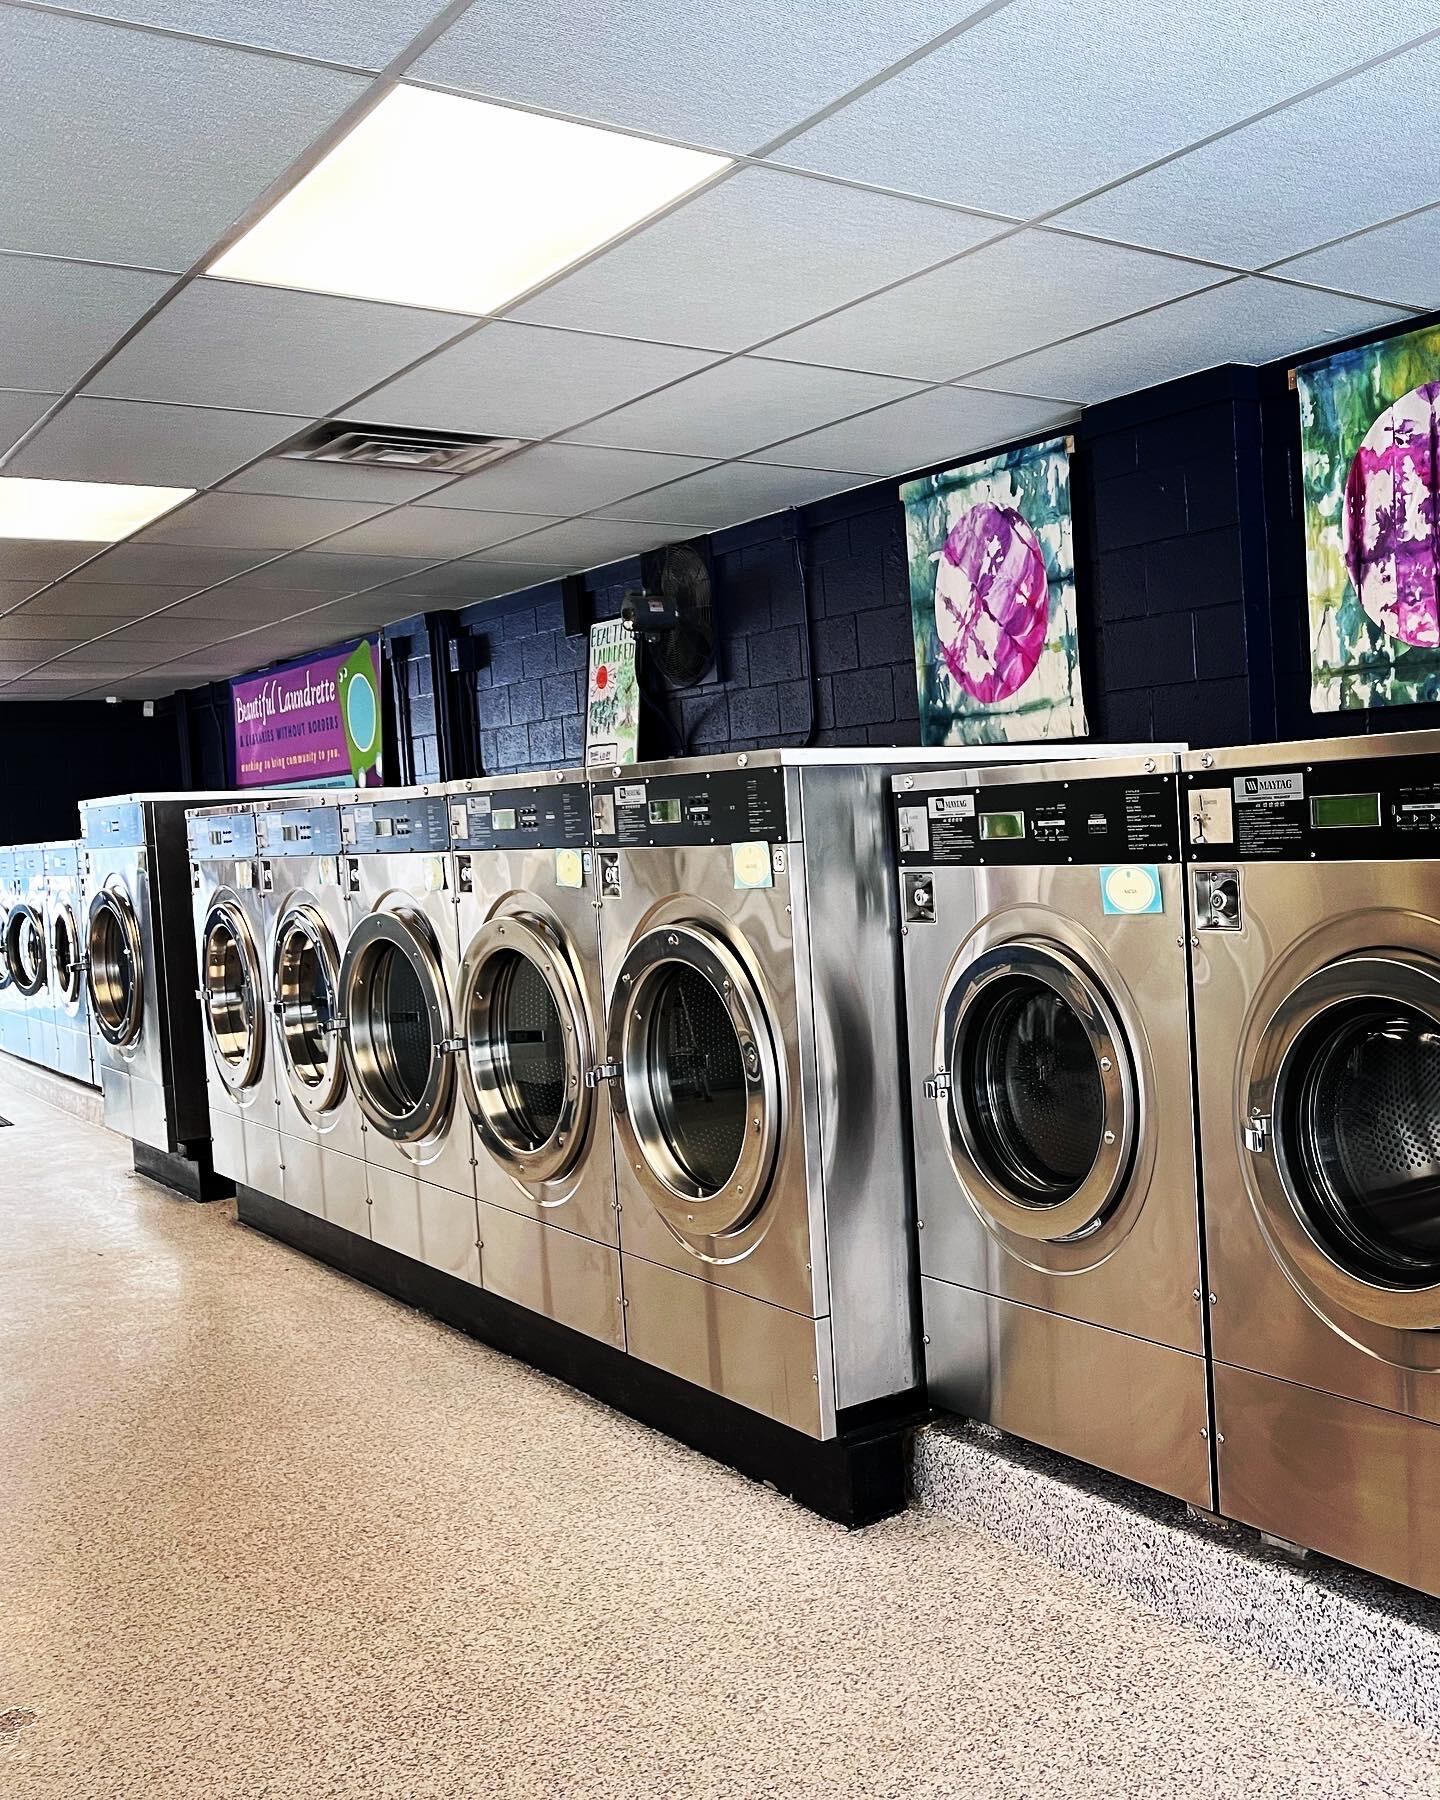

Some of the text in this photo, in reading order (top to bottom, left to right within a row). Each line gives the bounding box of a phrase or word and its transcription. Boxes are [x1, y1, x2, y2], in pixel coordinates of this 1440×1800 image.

[591, 623, 634, 647] BEAUTI
[236, 670, 335, 726] Beautiful Laundrette
[276, 722, 306, 740] WITHOUT
[308, 715, 339, 734] BORDERS
[286, 752, 317, 764] community
[318, 750, 325, 761] to
[1259, 779, 1292, 790] MAYTAG
